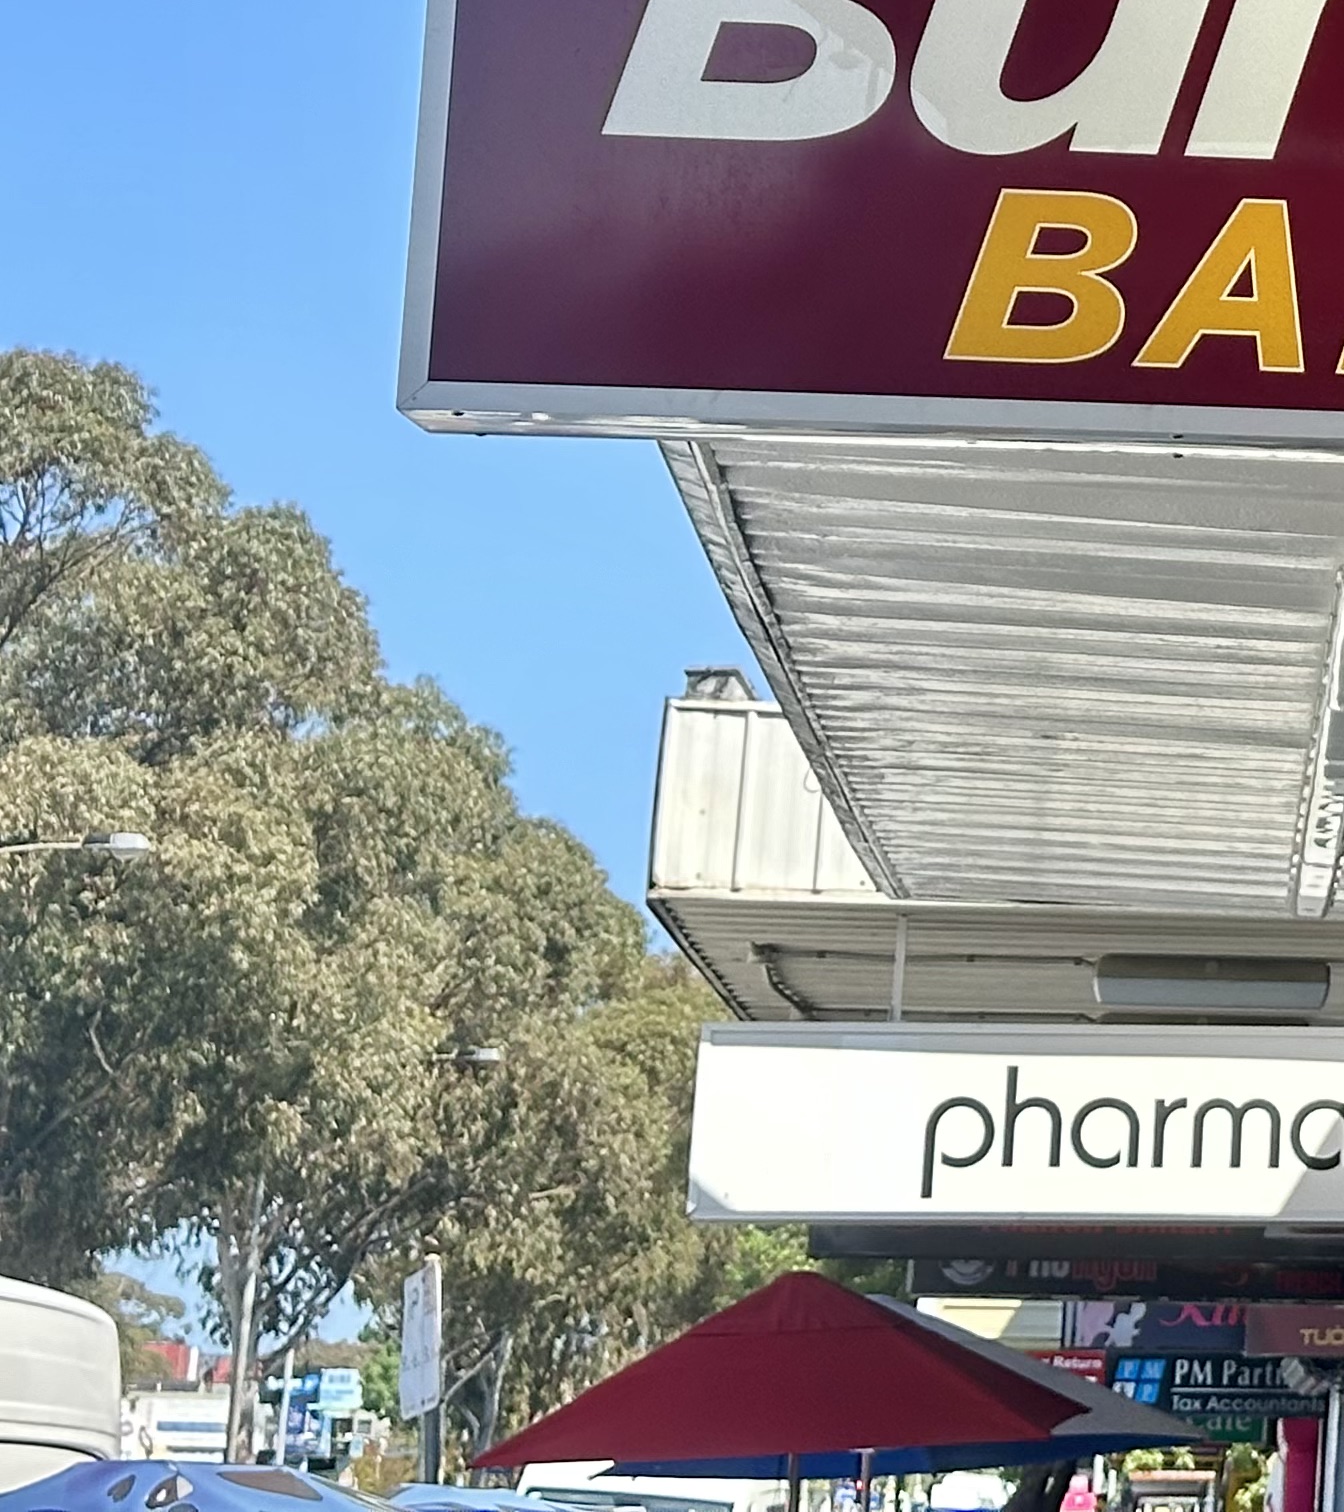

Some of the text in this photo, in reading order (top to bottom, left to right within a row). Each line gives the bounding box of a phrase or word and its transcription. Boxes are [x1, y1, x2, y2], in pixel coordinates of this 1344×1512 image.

[1174, 1359, 1213, 1386] PM
[1171, 1394, 1326, 1413] Tax Accountants
